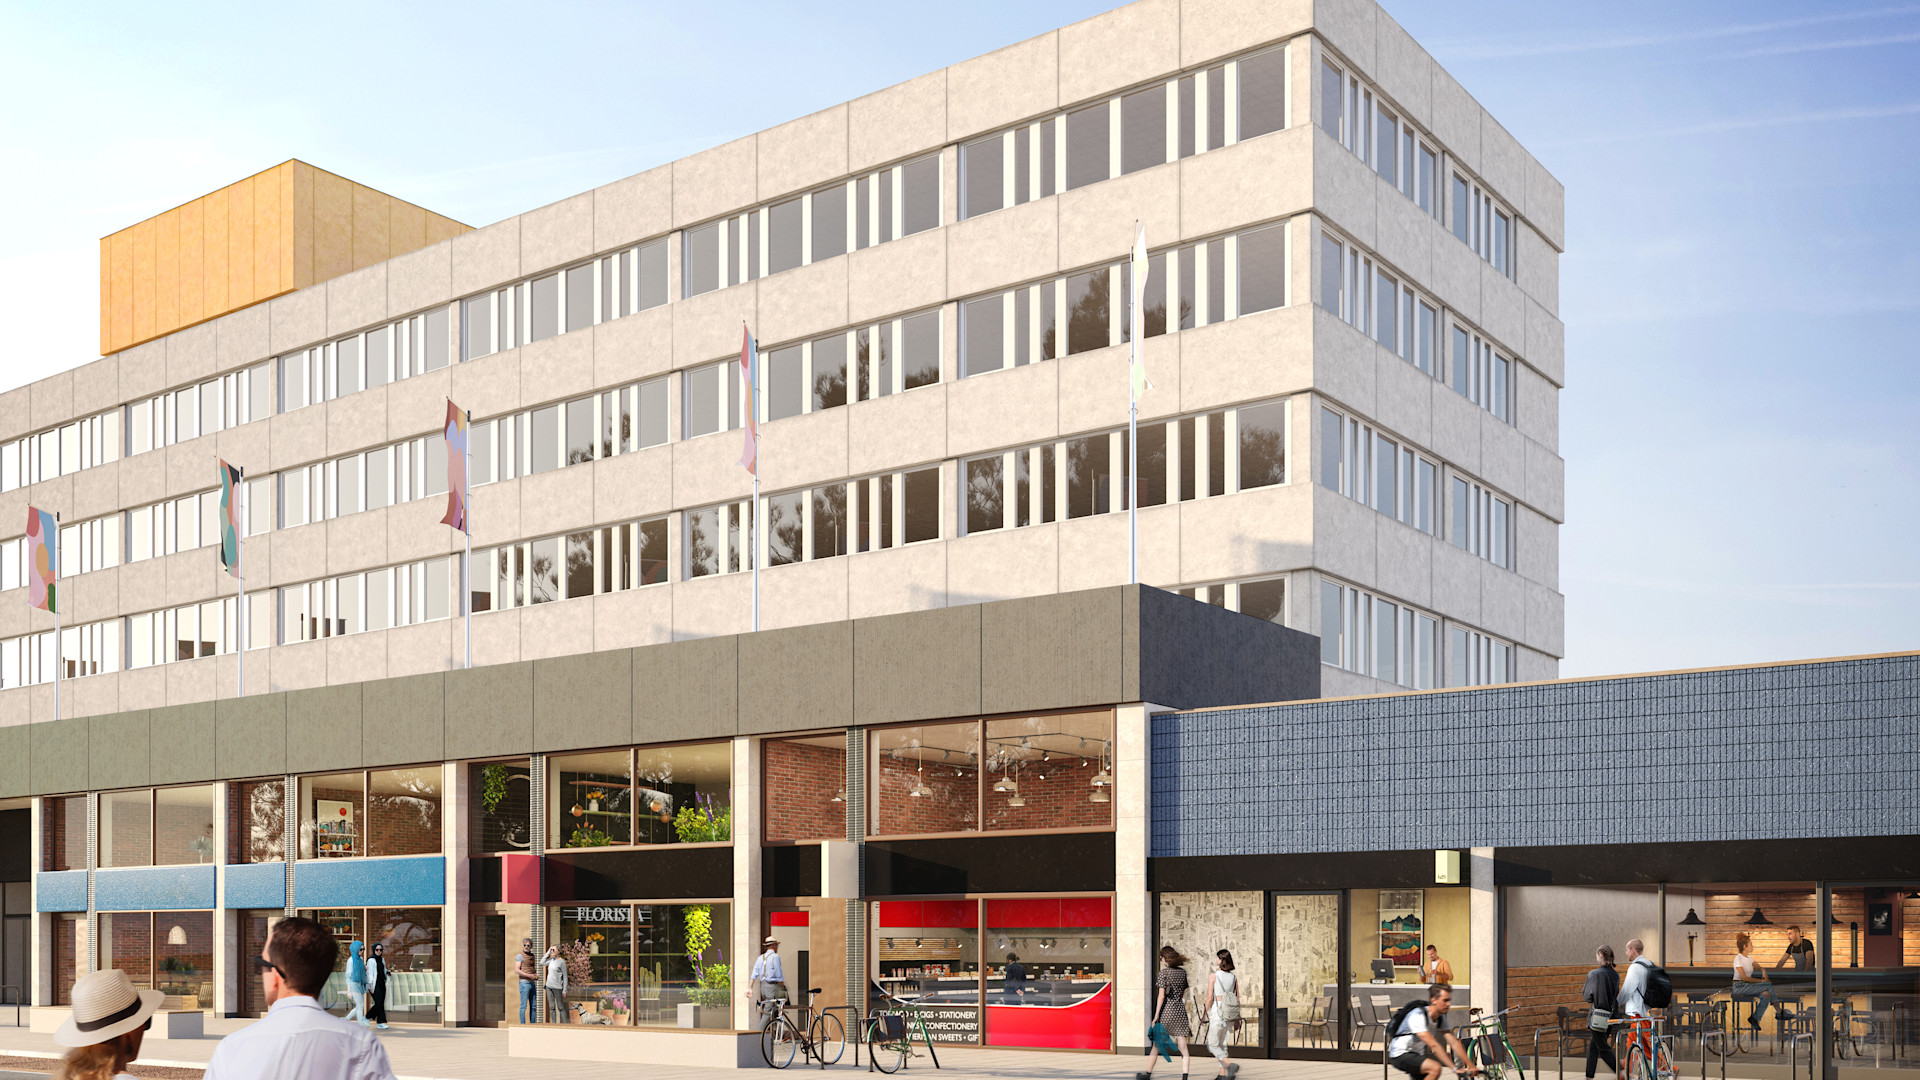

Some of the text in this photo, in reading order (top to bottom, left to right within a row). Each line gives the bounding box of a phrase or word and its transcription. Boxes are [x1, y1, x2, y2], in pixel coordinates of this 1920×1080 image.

[939, 1011, 977, 1019] STATIONERY
[925, 1022, 978, 1030] CONFECTIONERY
[938, 1033, 963, 1041] SWEETS
